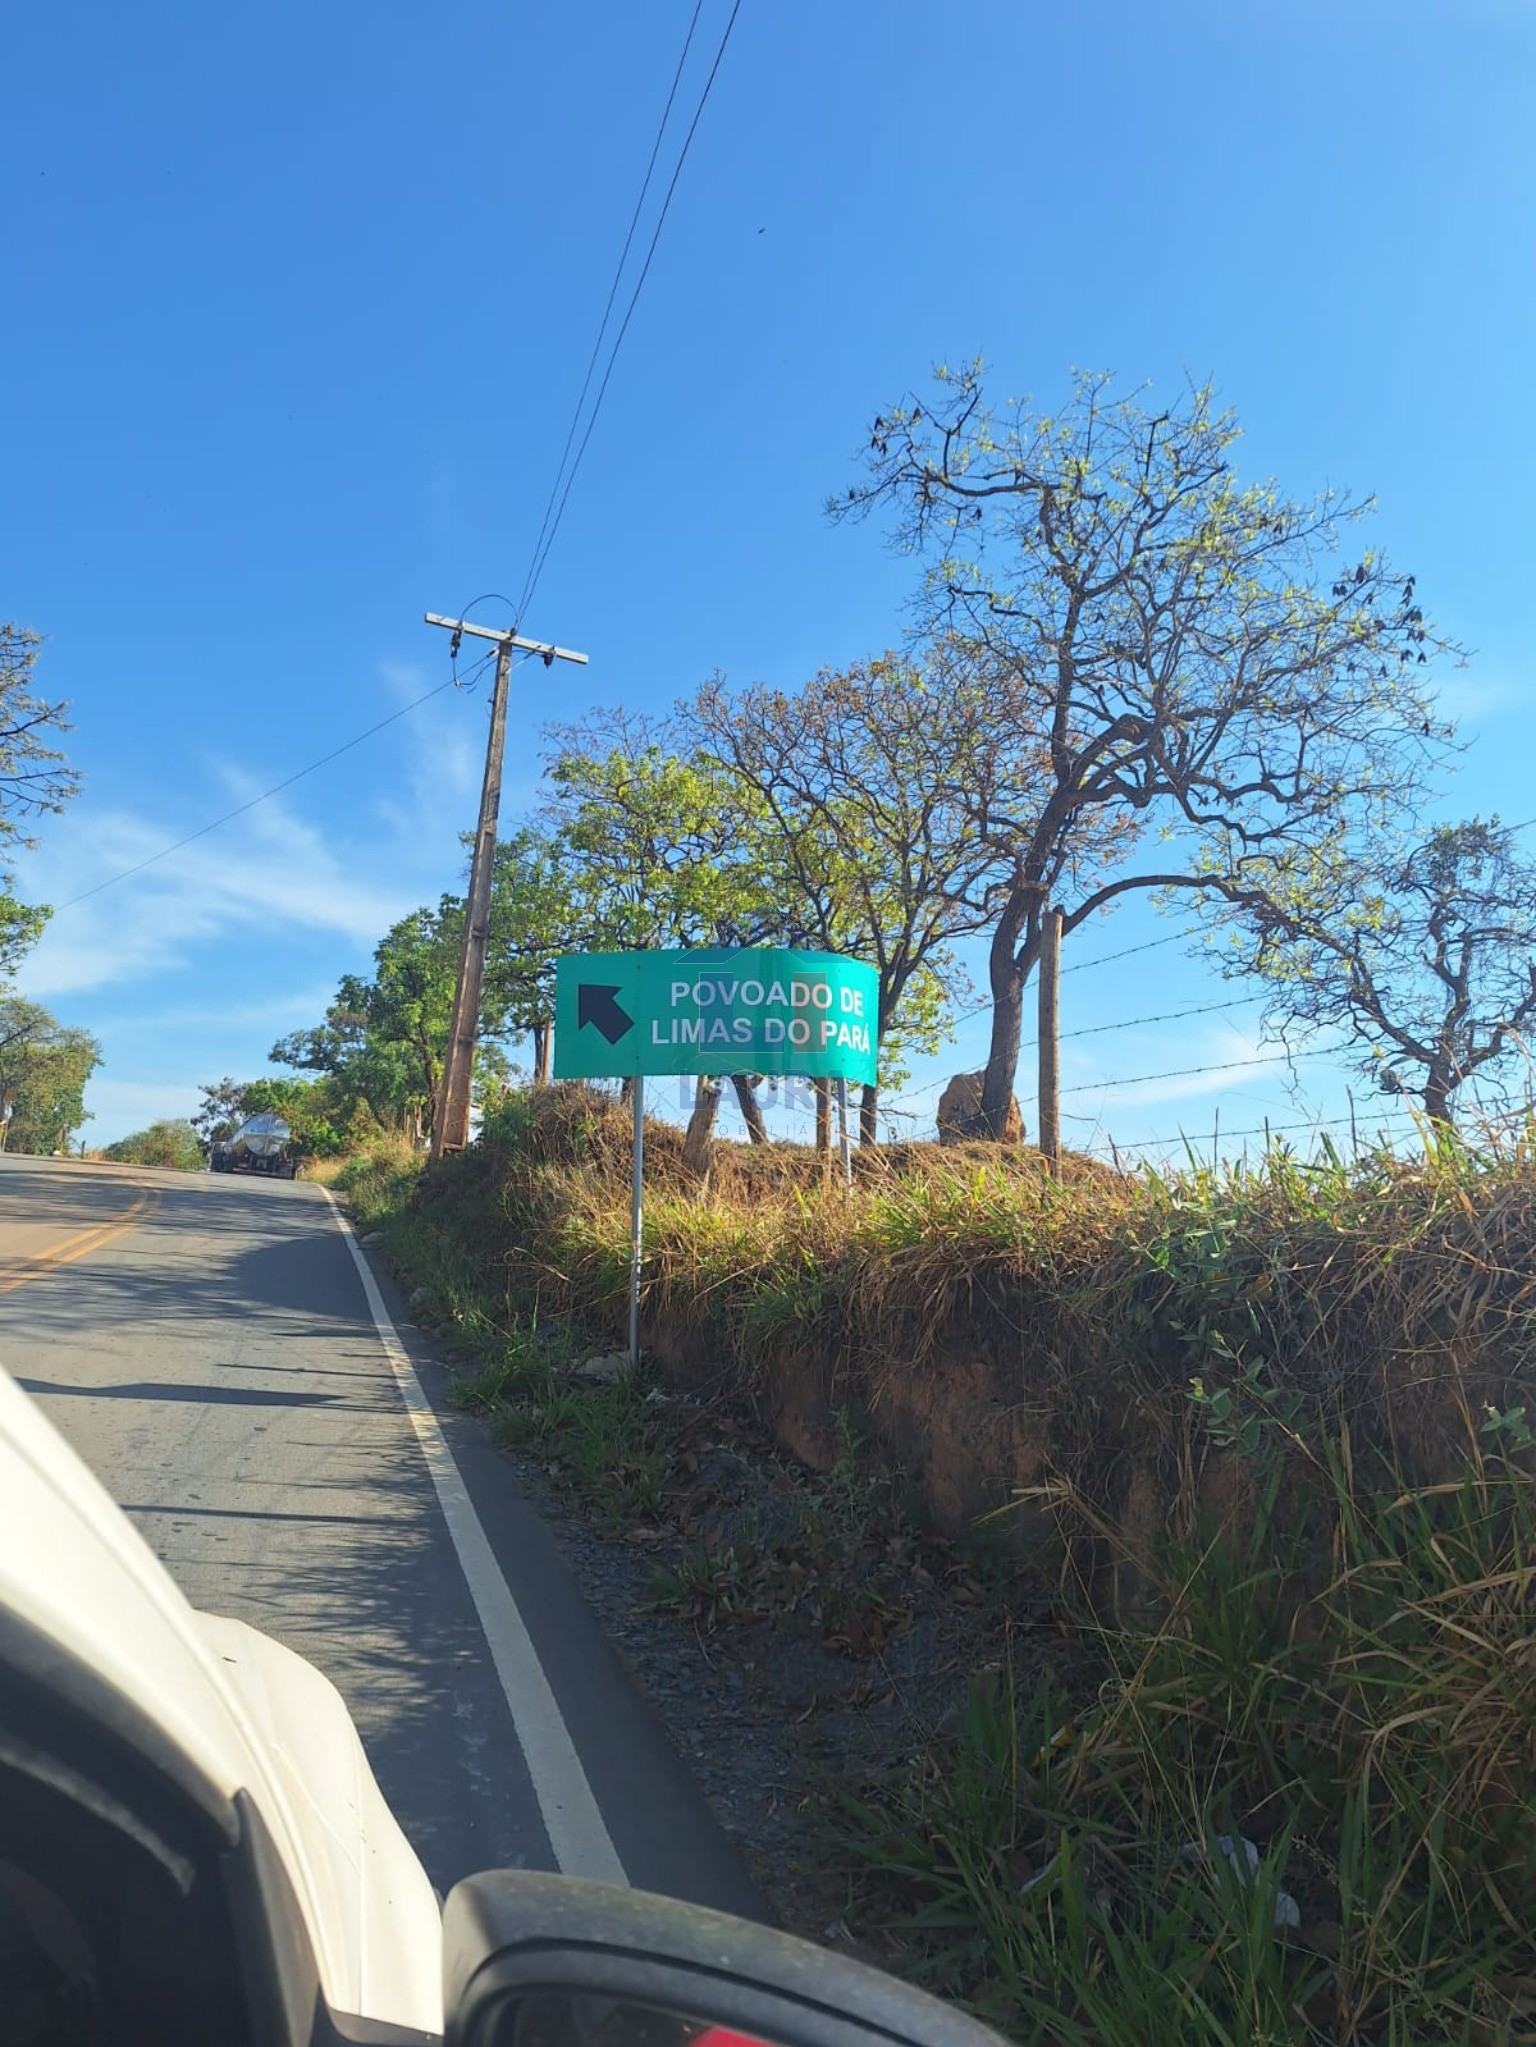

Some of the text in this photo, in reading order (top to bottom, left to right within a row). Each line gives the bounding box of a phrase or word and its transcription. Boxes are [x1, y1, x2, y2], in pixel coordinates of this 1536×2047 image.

[671, 980, 864, 1017] POVOADO DE
[652, 1017, 871, 1055] LIMAS DO PARÁ
